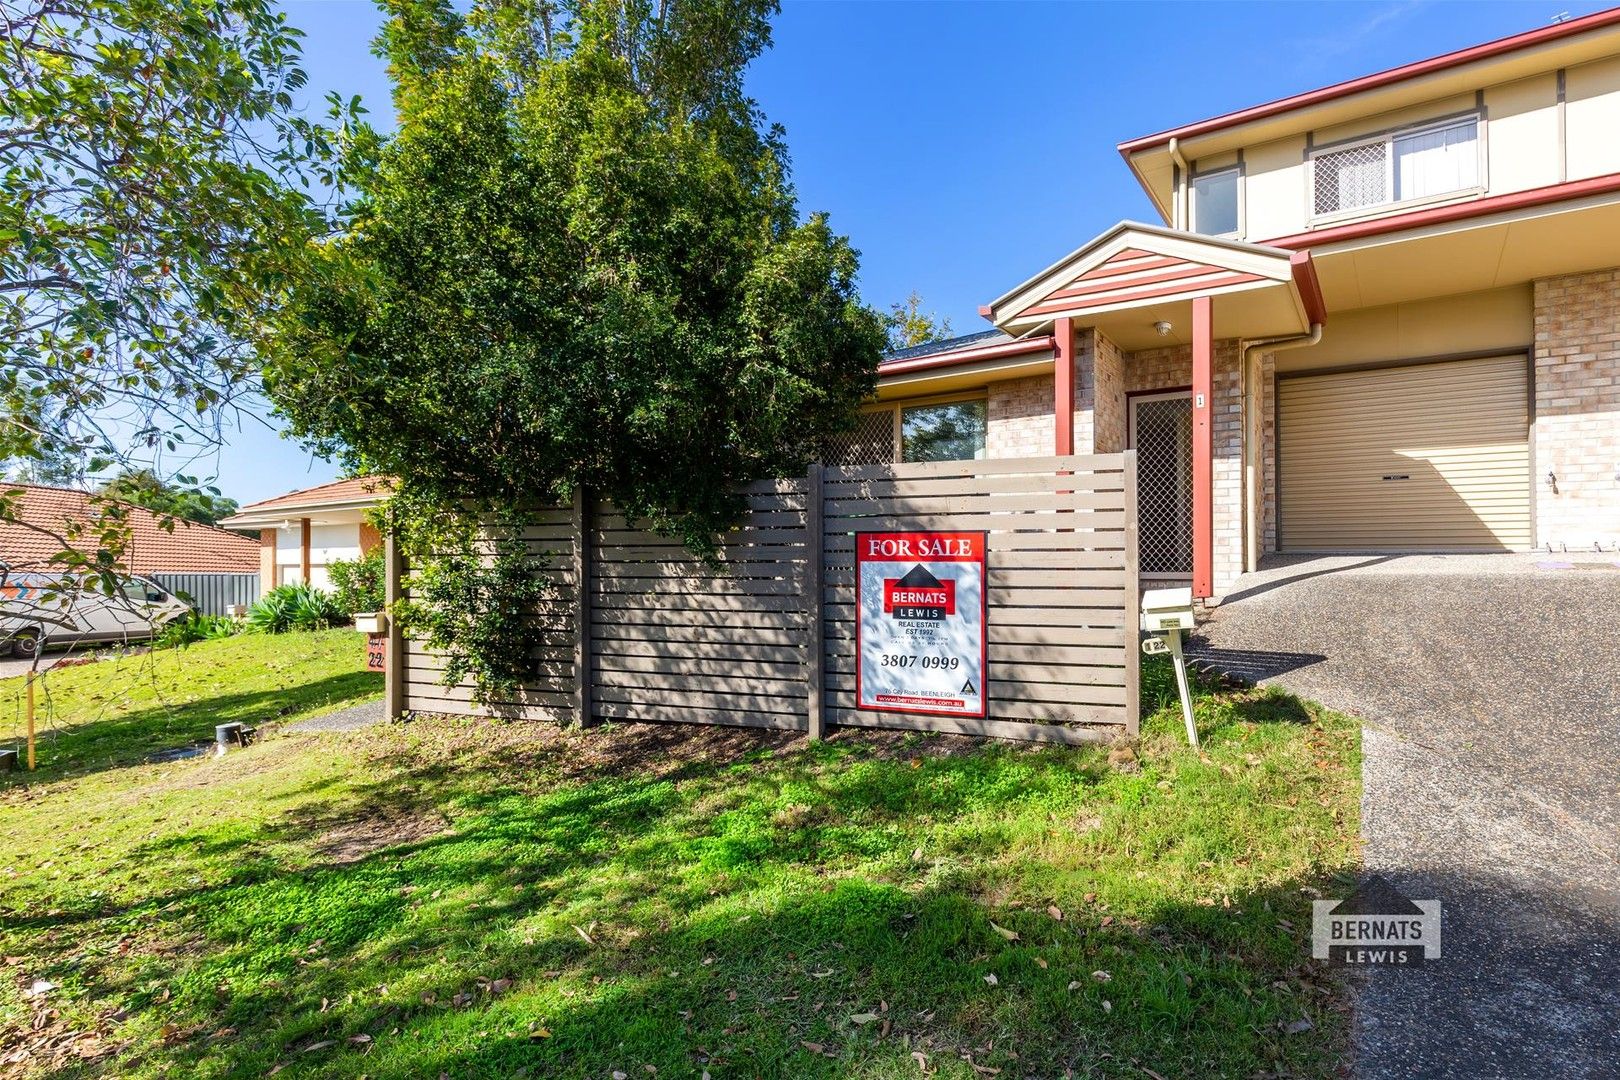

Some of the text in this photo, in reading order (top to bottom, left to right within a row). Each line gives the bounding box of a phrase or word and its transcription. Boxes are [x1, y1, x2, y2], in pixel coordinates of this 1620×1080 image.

[868, 539, 973, 557] FOR SALE
[892, 592, 947, 604] BERNATS
[900, 608, 938, 617] LEWIS
[1153, 641, 1166, 650] 22
[881, 654, 959, 670] 3807 0999
[892, 688, 903, 696] City
[920, 690, 956, 698] BEENLEIGH
